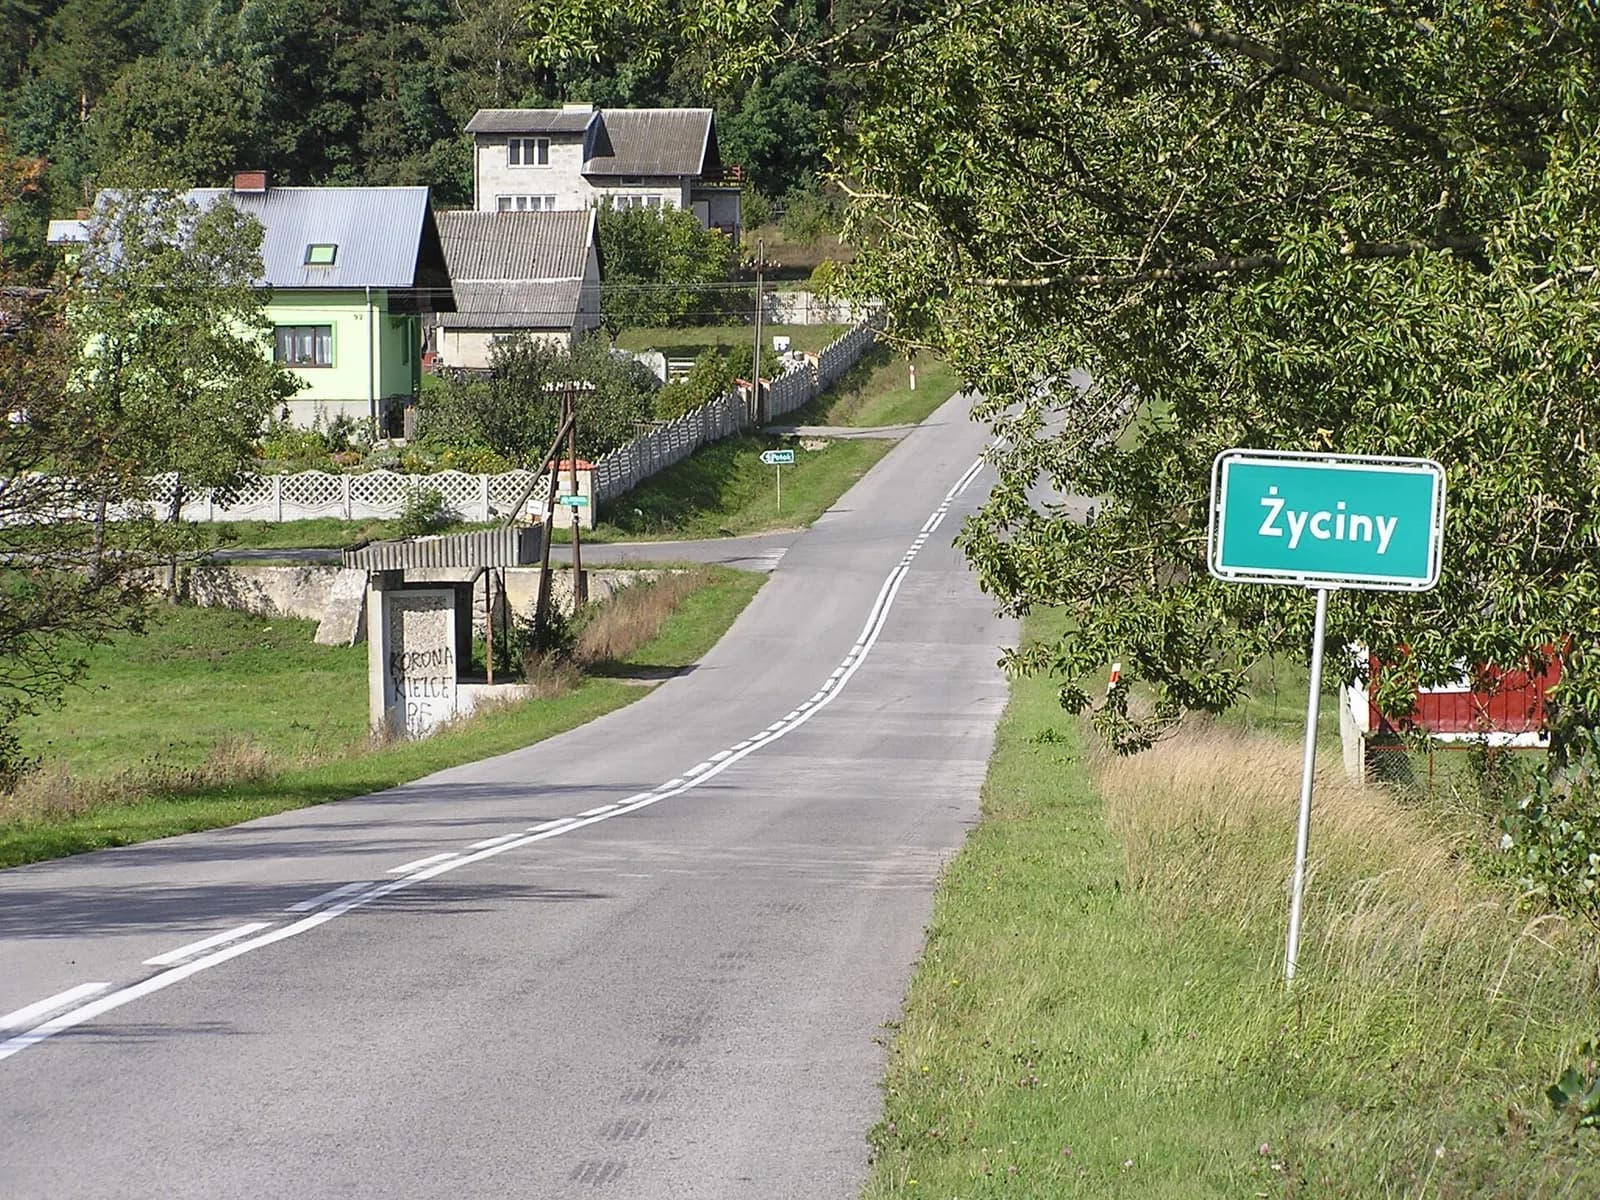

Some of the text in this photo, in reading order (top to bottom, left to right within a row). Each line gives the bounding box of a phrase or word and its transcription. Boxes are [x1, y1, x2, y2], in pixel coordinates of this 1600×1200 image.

[1258, 486, 1398, 555] Życiny
[389, 646, 454, 676] KORONA
[393, 676, 453, 701] KIELCE
